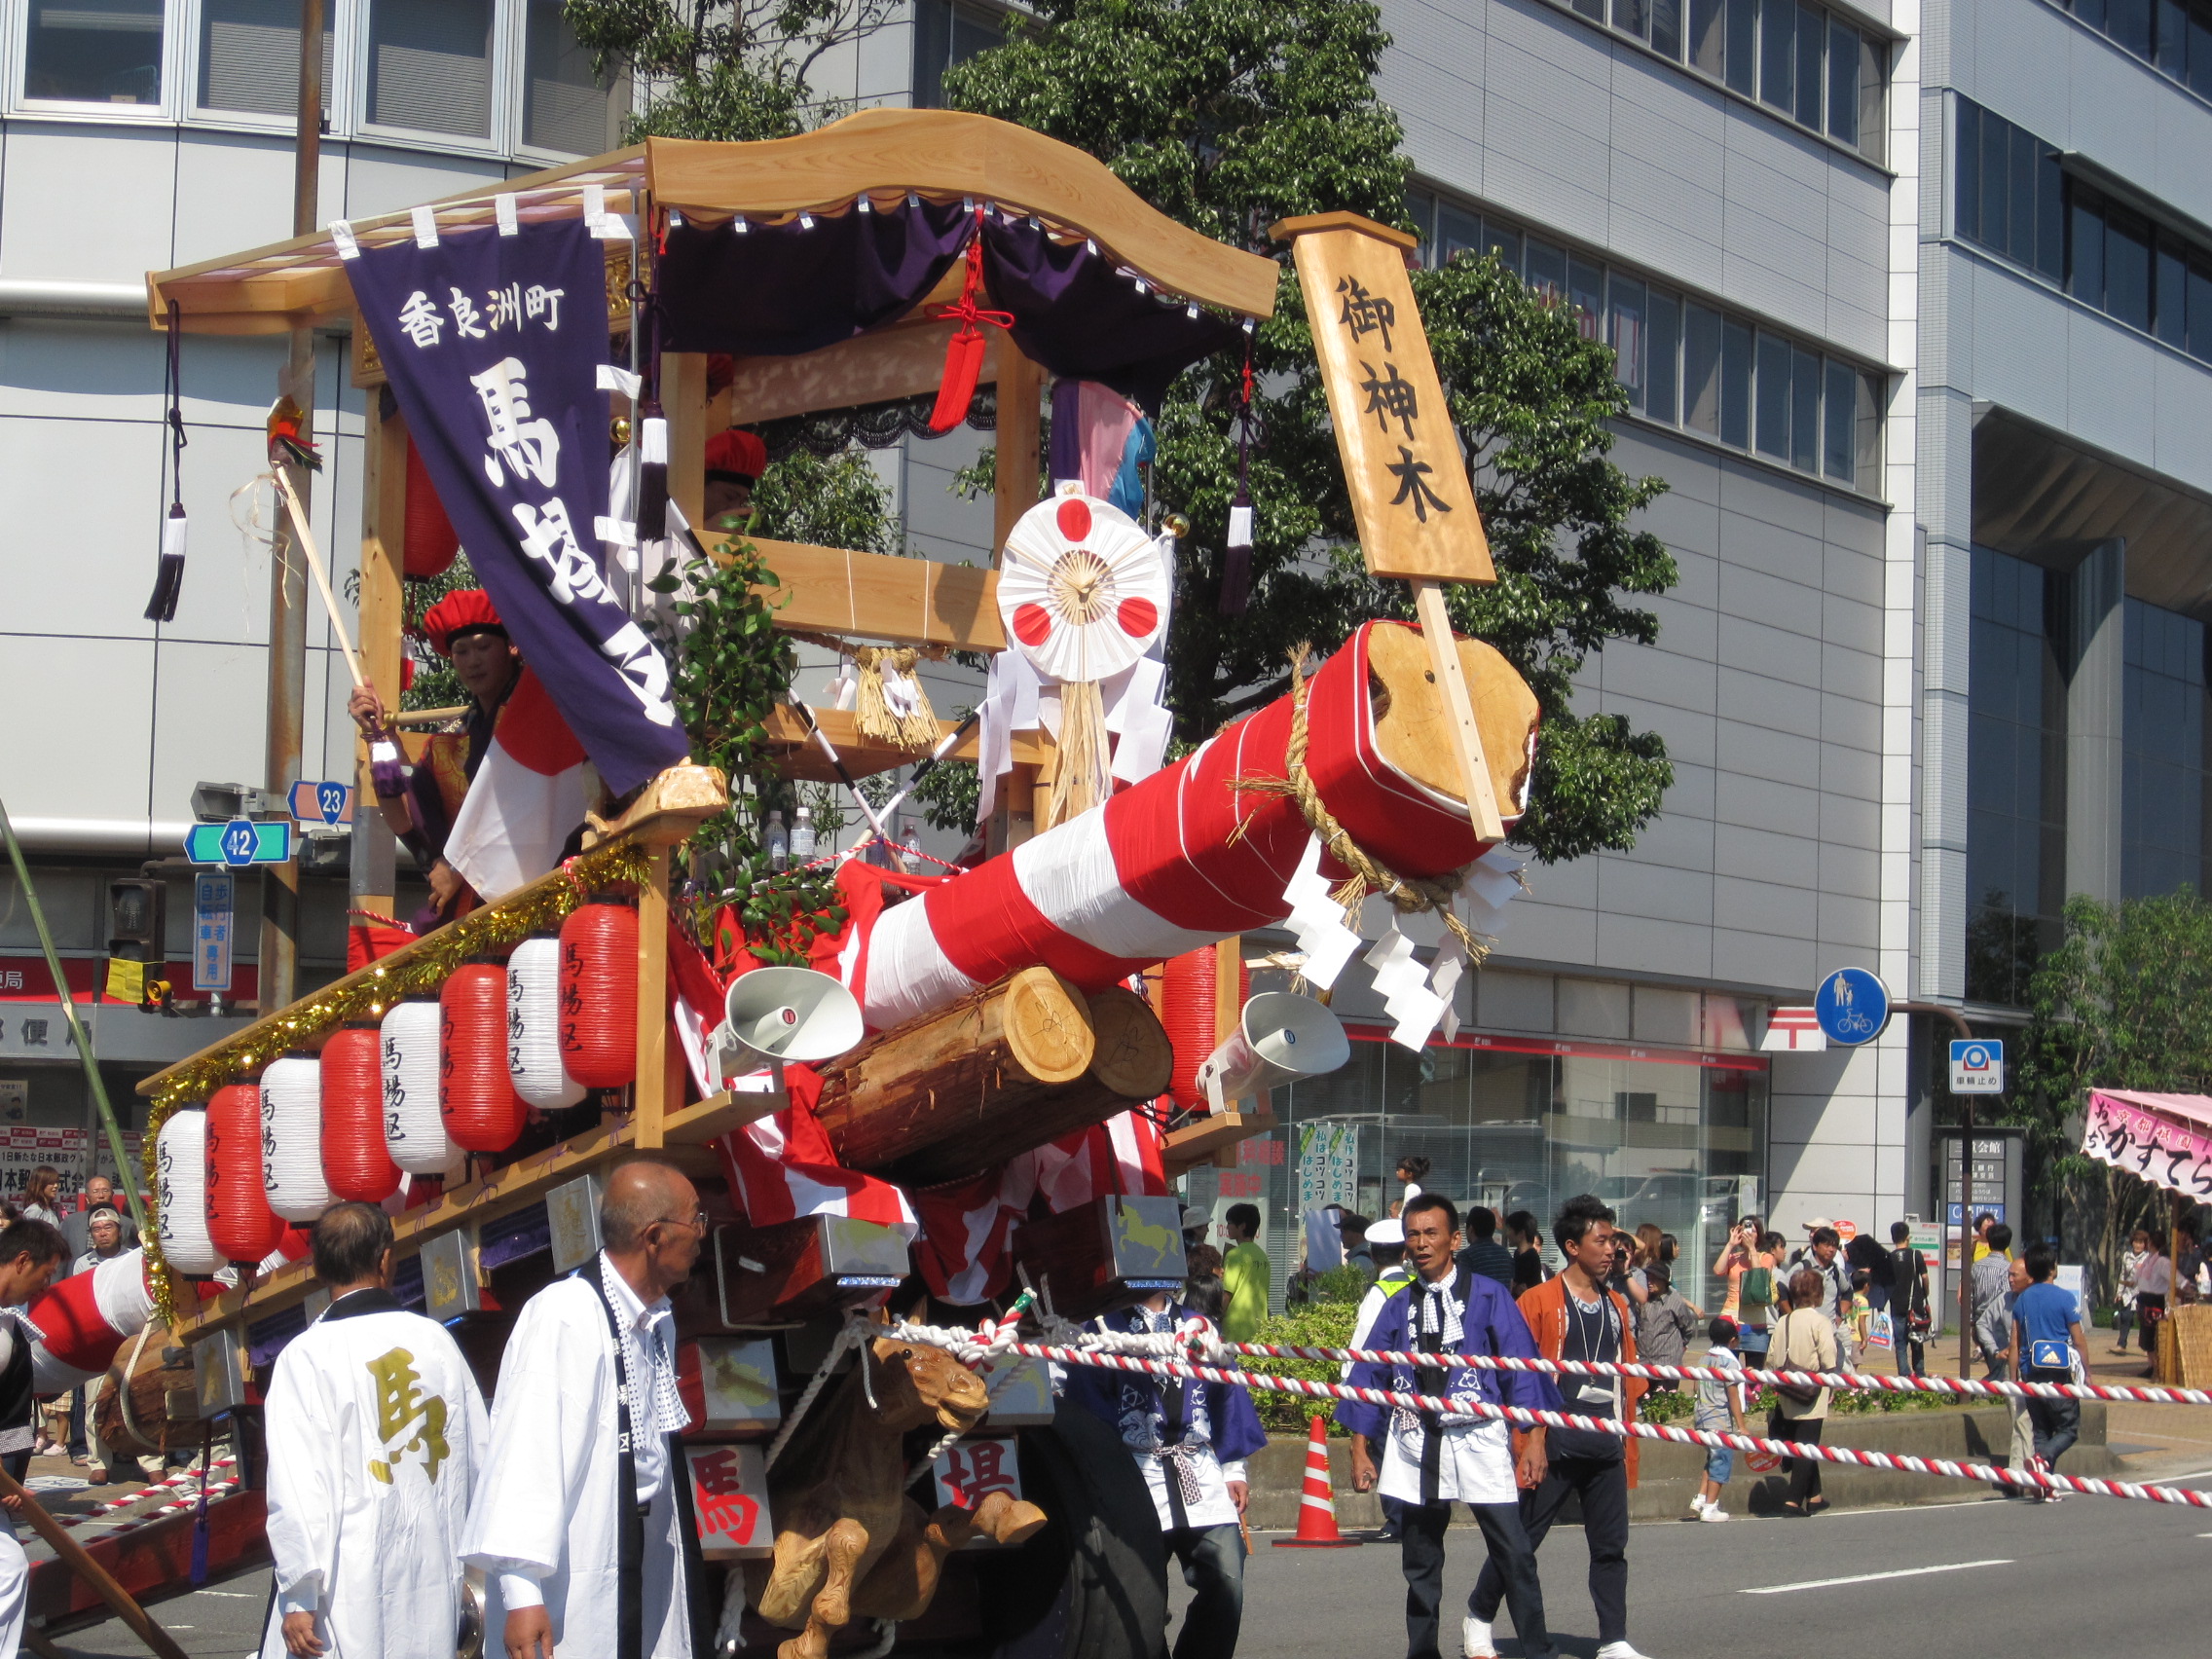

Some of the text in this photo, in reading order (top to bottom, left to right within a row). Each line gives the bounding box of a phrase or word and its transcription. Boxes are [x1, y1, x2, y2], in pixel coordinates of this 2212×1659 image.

[398, 281, 565, 349] 香良洲町
[1336, 275, 1453, 524] 御神木
[227, 830, 250, 856] 42
[322, 789, 341, 813] 23
[0, 971, 23, 989] 局
[508, 969, 525, 1075] 馬場区
[562, 942, 584, 1051] 馬場区
[383, 1036, 406, 1141] 馬場区
[1956, 1076, 1997, 1086] 車輪止め
[157, 1140, 174, 1240] 馬場区
[2105, 1123, 2212, 1196] かすてら
[367, 1346, 448, 1486] 馬
[690, 1449, 759, 1546] 馬
[940, 1441, 1016, 1511] 場
